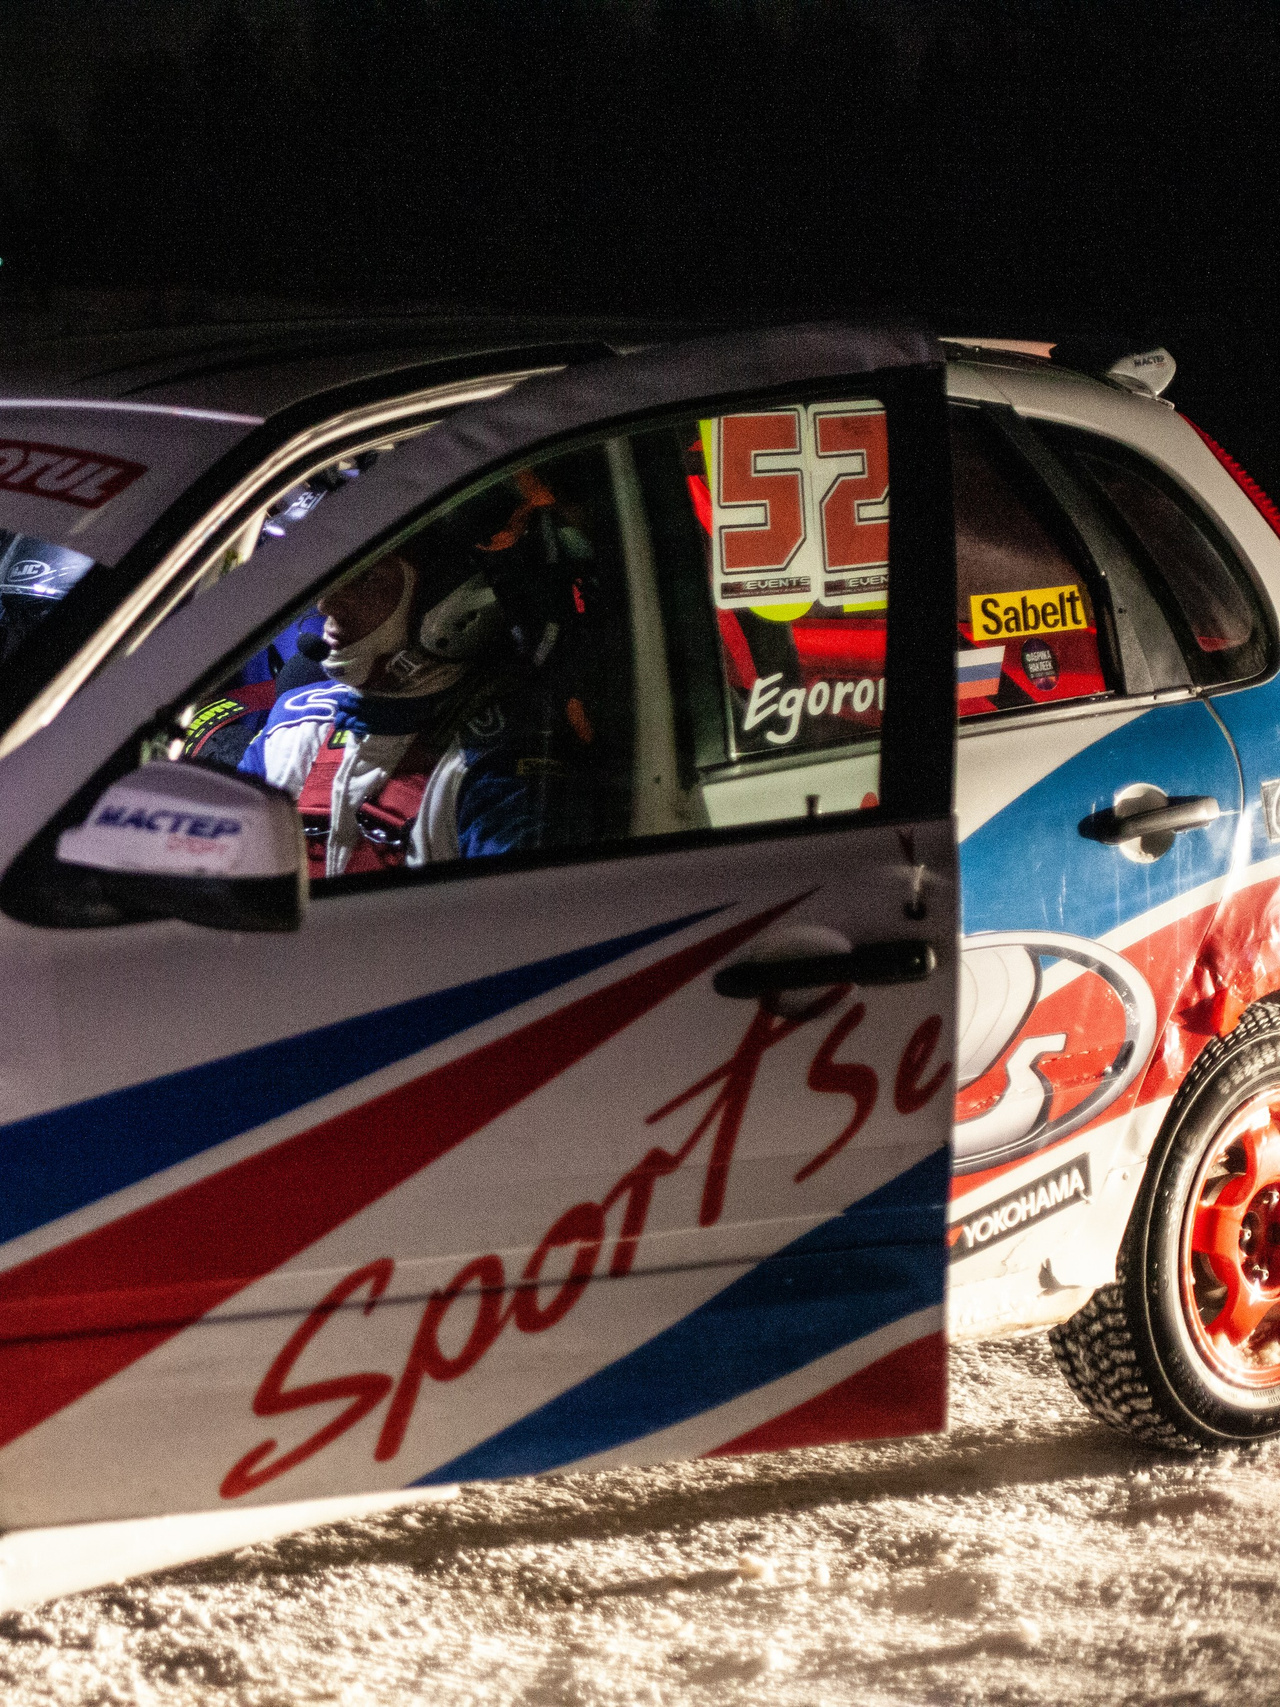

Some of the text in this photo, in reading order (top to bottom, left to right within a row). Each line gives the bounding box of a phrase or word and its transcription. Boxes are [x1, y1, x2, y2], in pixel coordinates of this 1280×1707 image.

[720, 408, 888, 575] 52
[980, 590, 1081, 635] Sabelt
[95, 805, 242, 839] МАСТЕР
[962, 1168, 1086, 1248] YOKOHAMA
